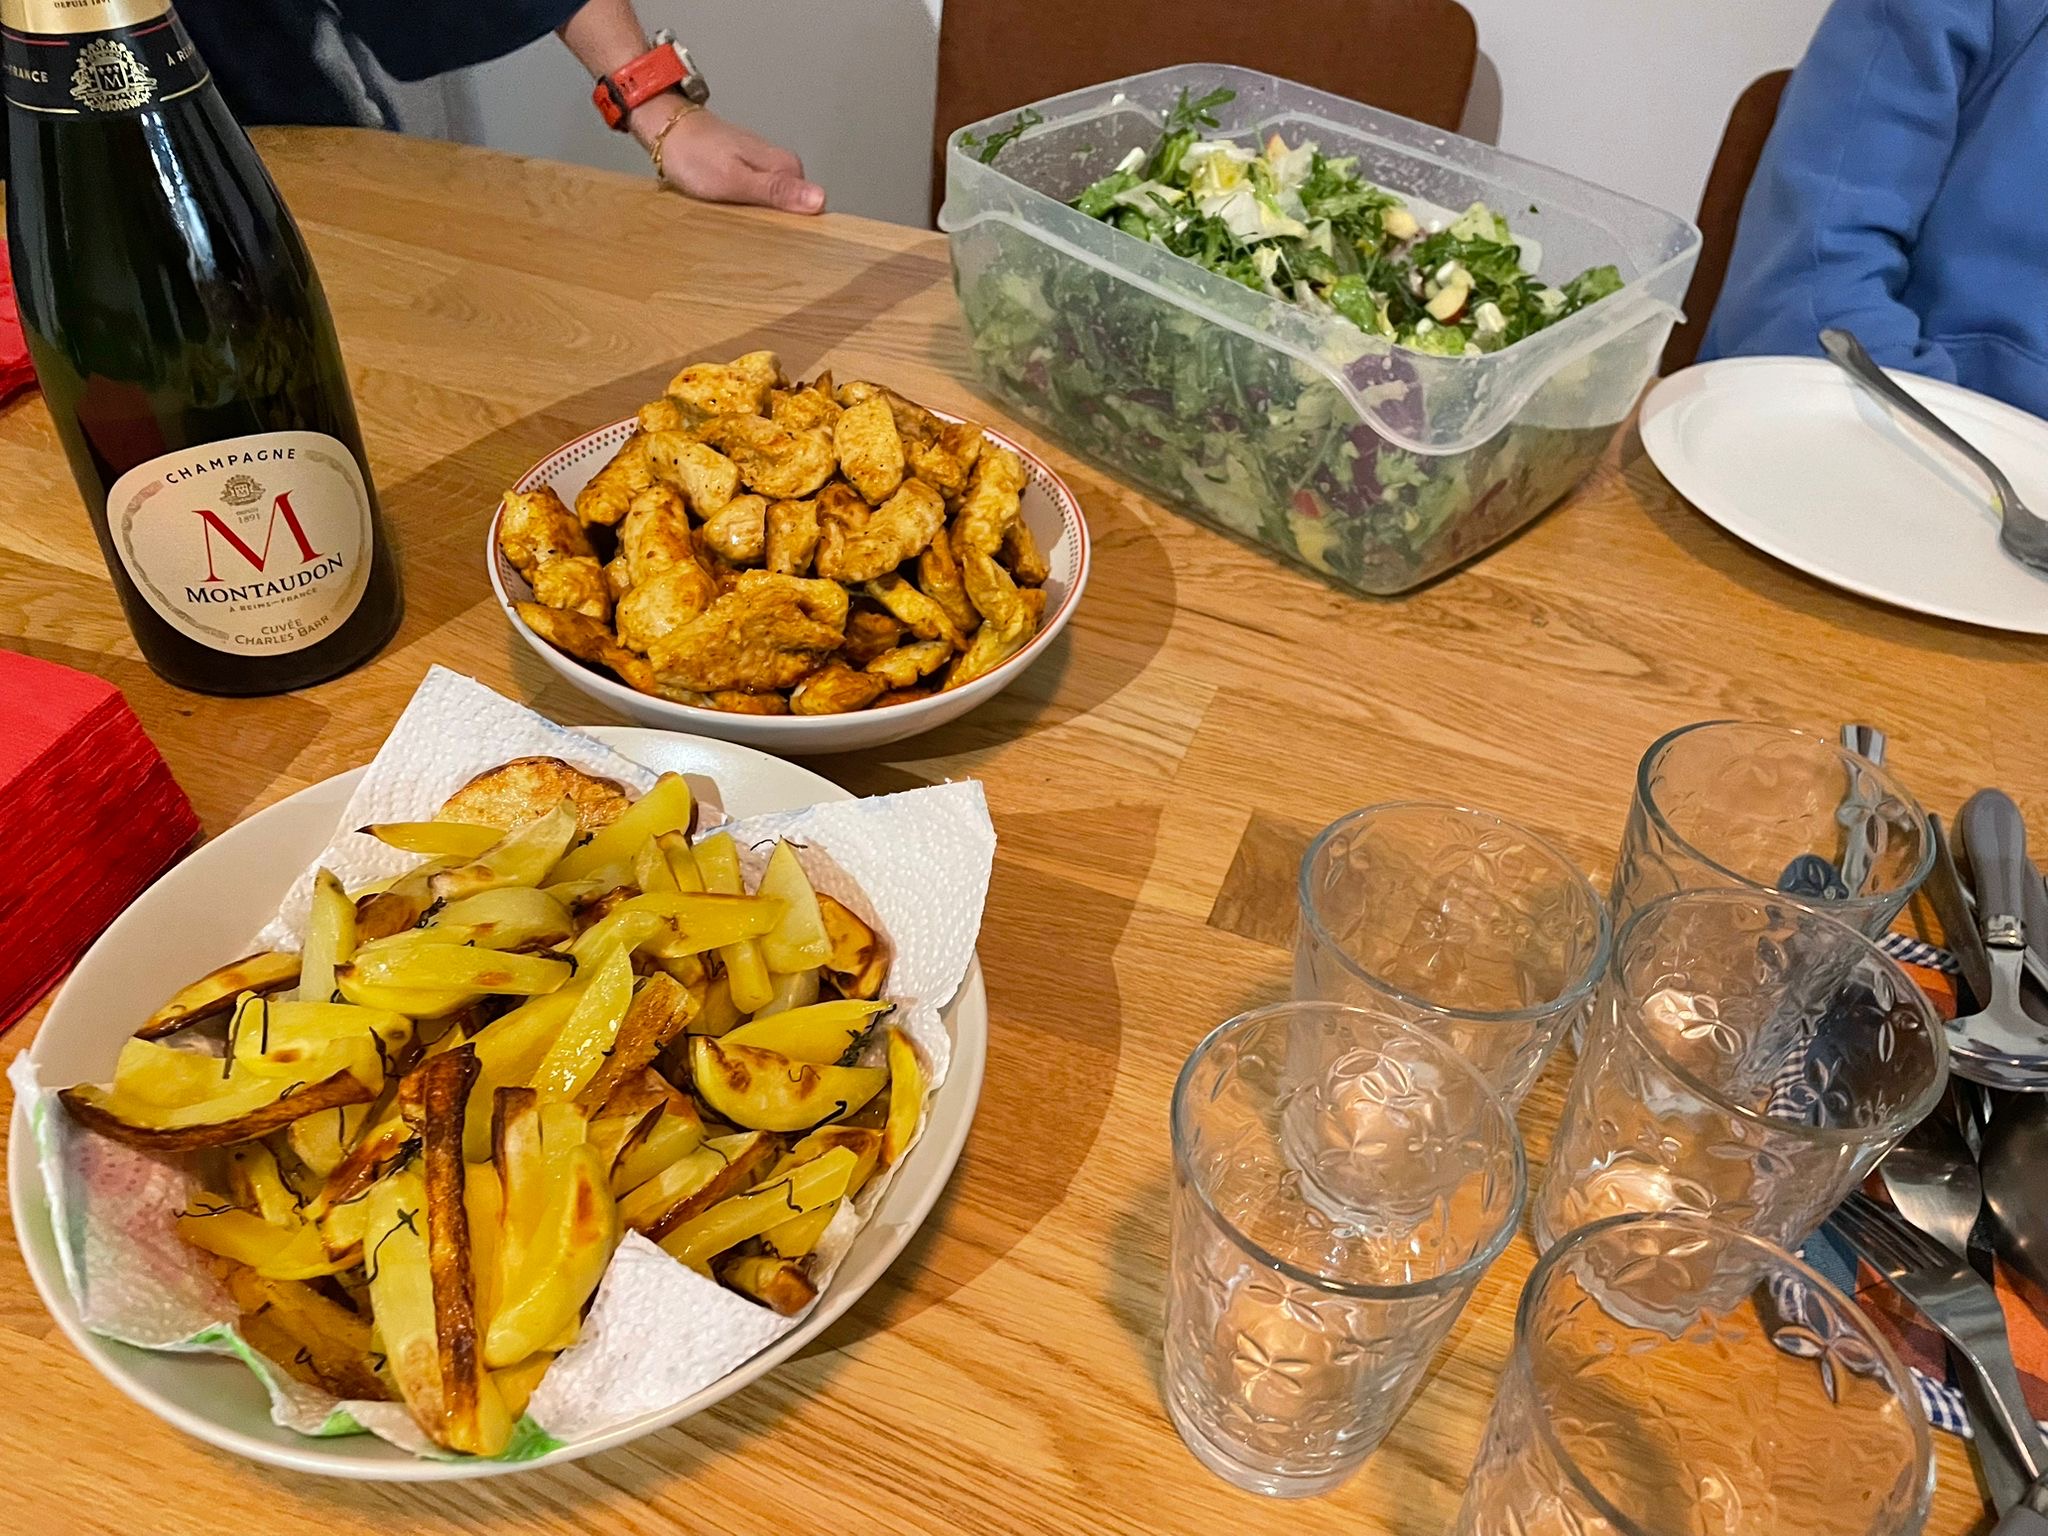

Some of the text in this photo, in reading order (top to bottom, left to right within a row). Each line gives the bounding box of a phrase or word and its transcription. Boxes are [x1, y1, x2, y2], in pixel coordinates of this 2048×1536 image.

[103, 74, 124, 90] M
[165, 448, 296, 485] CHAMPAGNE
[192, 489, 324, 582] M
[185, 552, 344, 604] MONTAUDON
[234, 615, 329, 646] CHARLES BARR
[261, 618, 303, 635] CUVÉE
